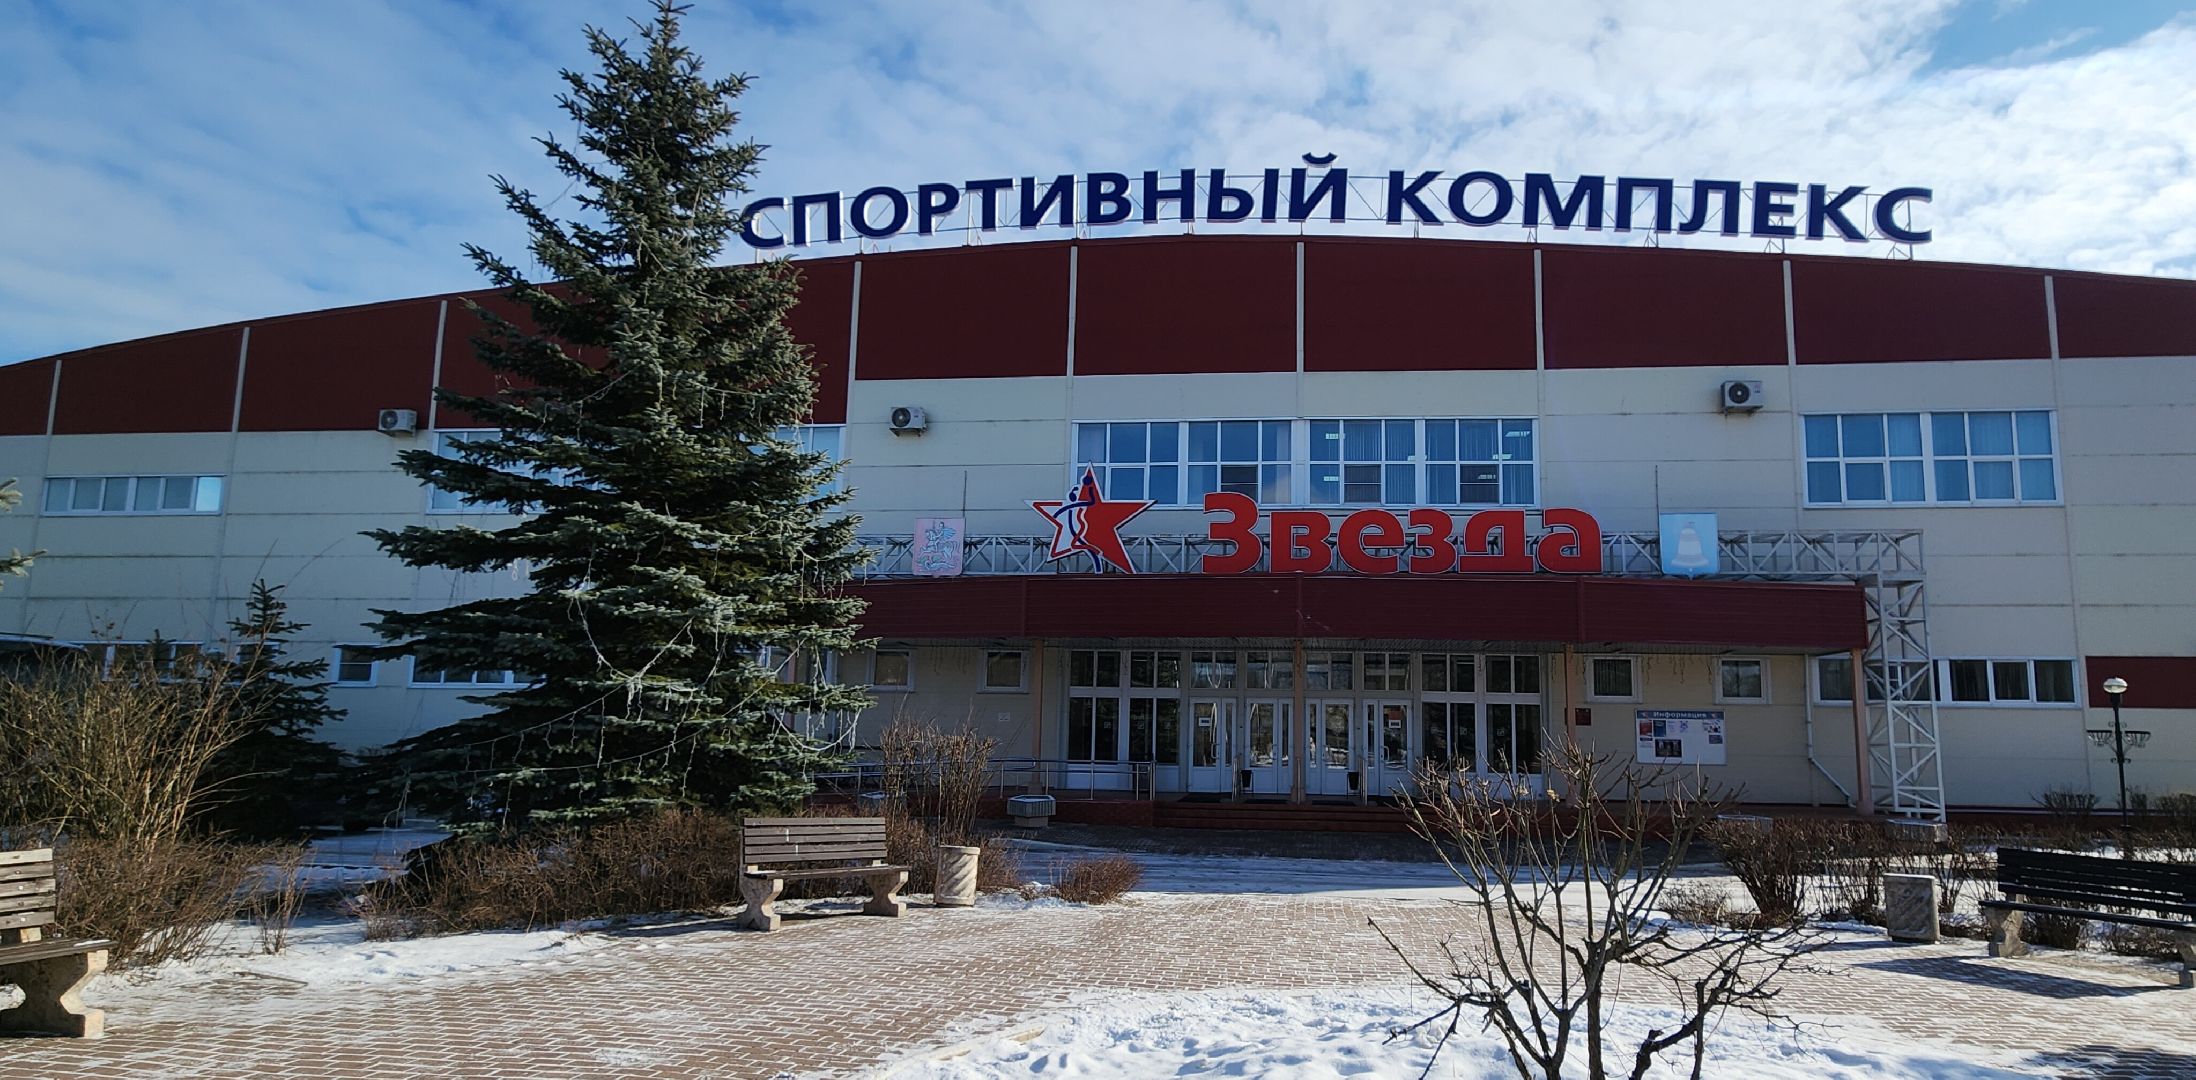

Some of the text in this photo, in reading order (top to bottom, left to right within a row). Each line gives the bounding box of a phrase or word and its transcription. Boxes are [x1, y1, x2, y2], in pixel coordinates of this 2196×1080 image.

[742, 152, 1933, 248] СПОРТИВНЫЙ КОМПЛЕКС
[1202, 491, 1603, 574] Звезда
[1653, 711, 1707, 719] Информация
